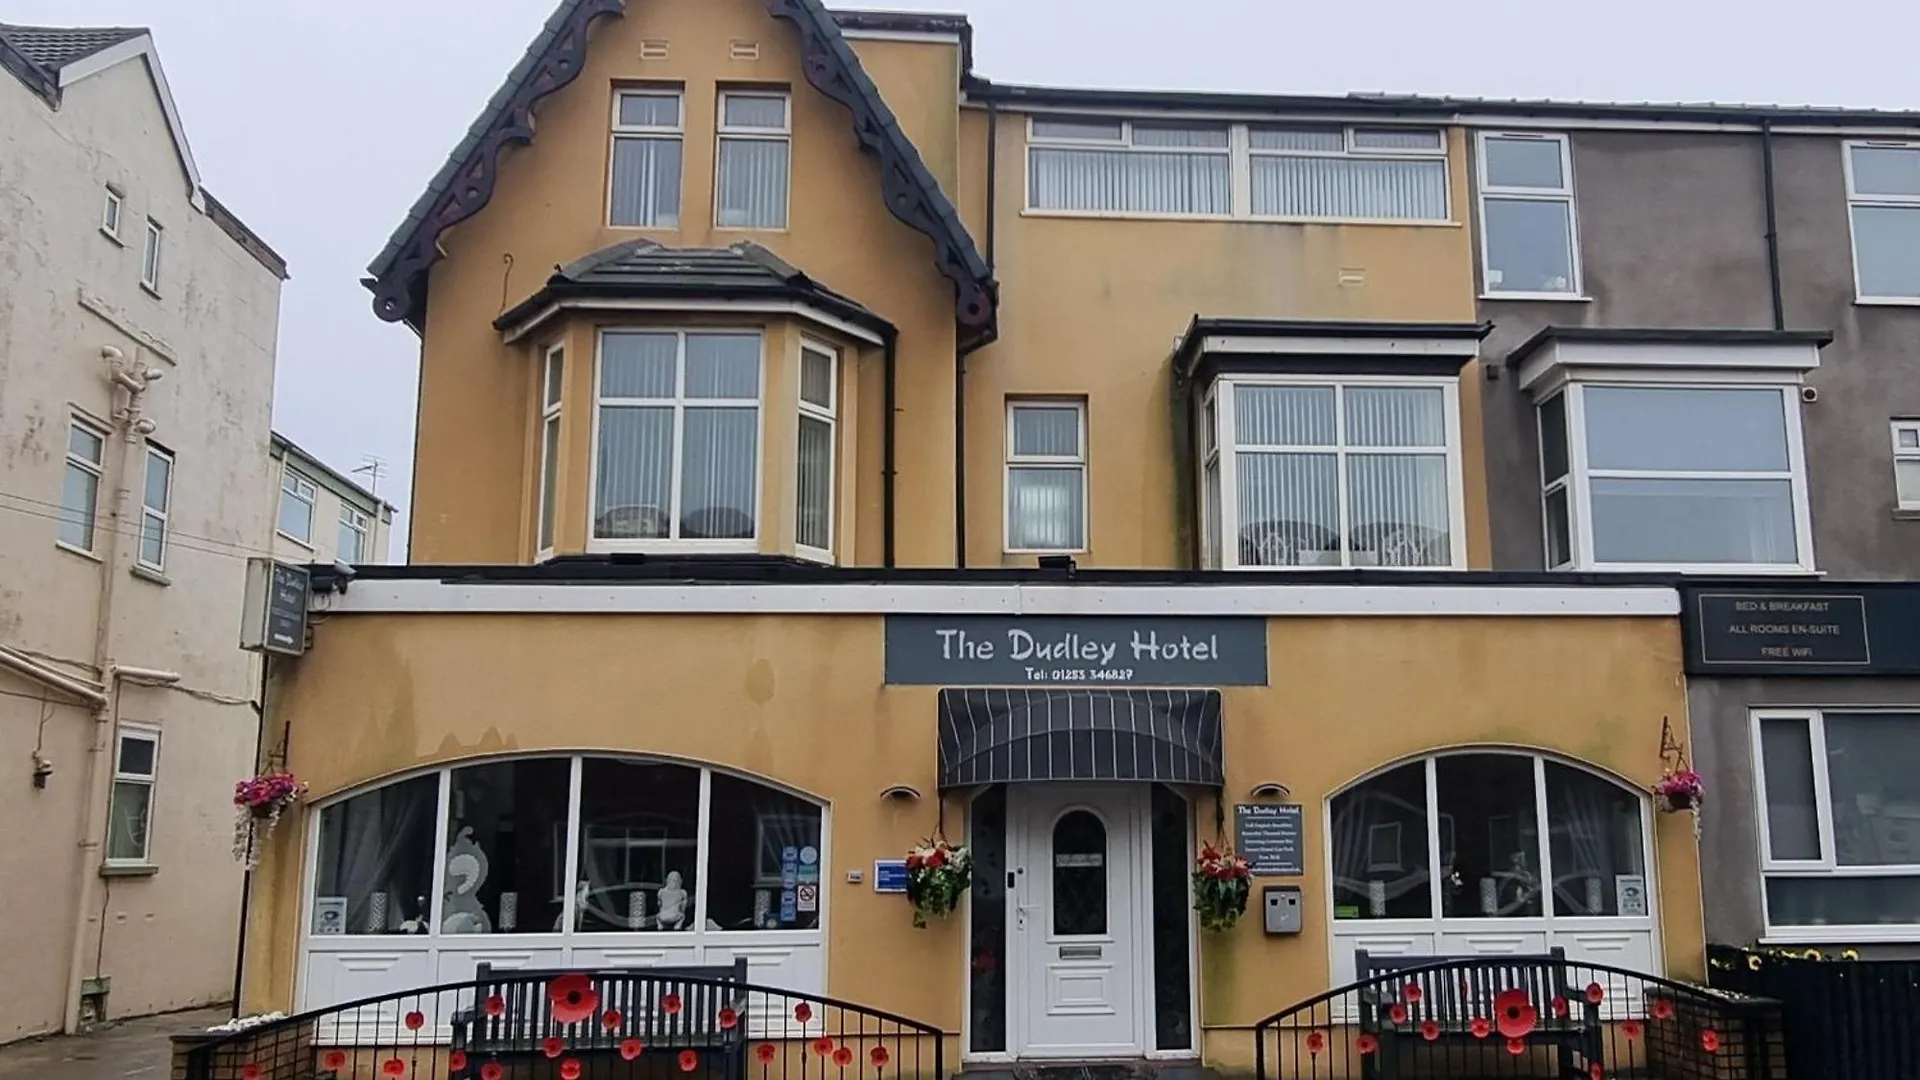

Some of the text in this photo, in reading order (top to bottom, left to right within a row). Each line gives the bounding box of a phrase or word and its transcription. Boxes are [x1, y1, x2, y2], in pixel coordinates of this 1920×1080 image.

[1735, 601, 1830, 612] BED & BREAKFAST
[1729, 624, 1748, 634] ALL
[1750, 624, 1790, 635] ROOMS
[935, 628, 1219, 665] The Dudley Hotel
[1760, 647, 1790, 657] FREE
[1024, 666, 1049, 681] Tel:
